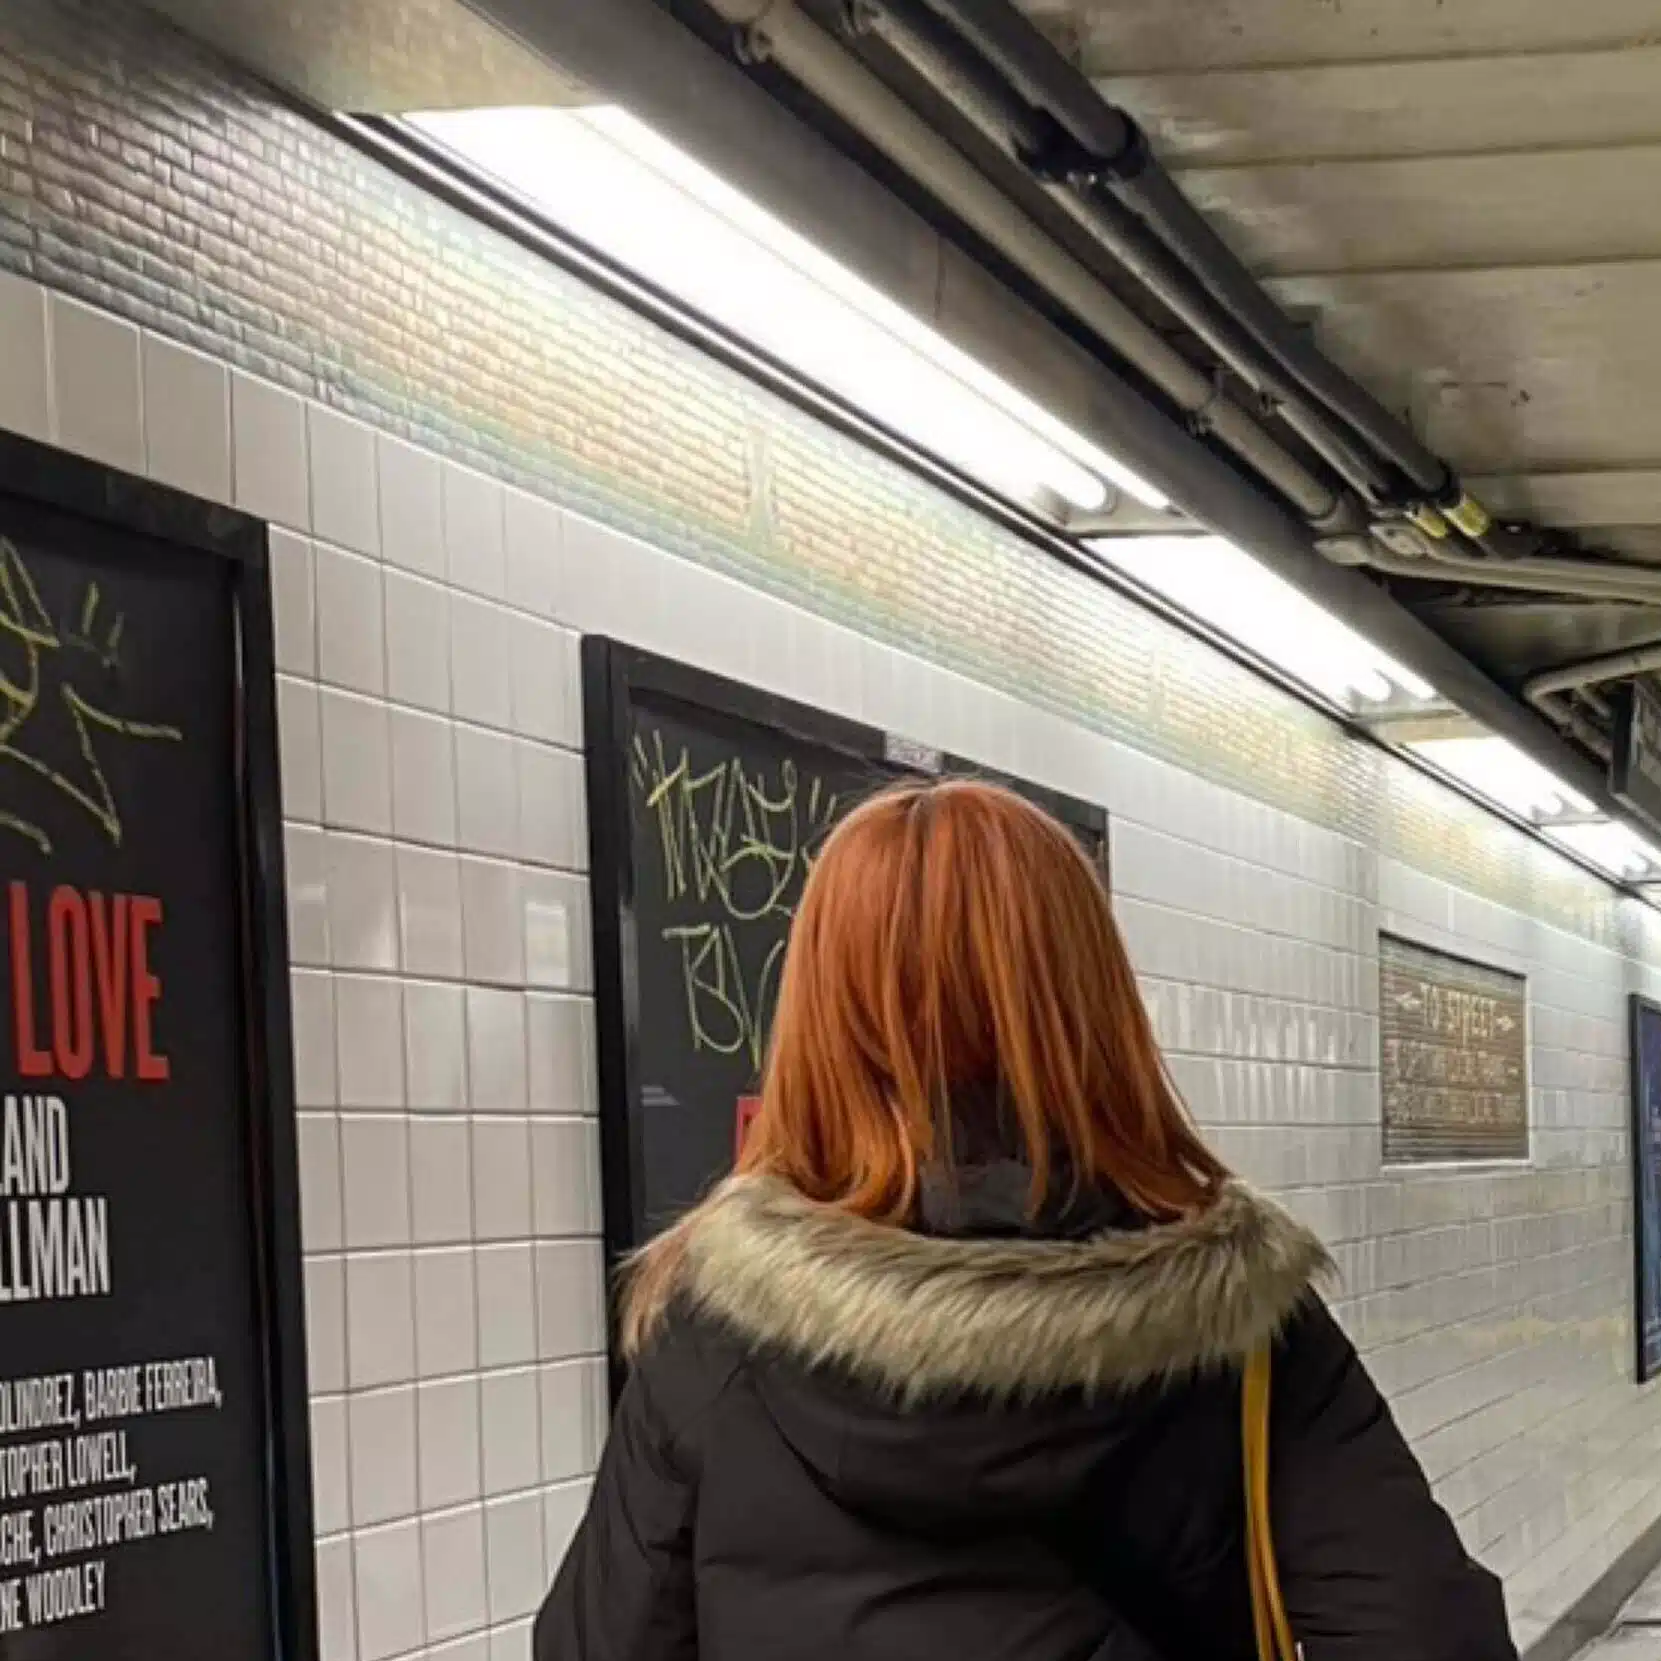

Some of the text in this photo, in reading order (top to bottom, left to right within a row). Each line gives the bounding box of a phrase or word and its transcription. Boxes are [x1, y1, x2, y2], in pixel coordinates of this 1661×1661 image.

[8, 881, 170, 1081] LOVE
[0, 1095, 71, 1195] AND
[83, 1364, 144, 1421] BARBIE
[67, 1429, 137, 1485] LOWELL,
[44, 1487, 156, 1557] CHRISTOPHER
[157, 1476, 214, 1533] SEARS,
[25, 1560, 105, 1625] WOODLEY
